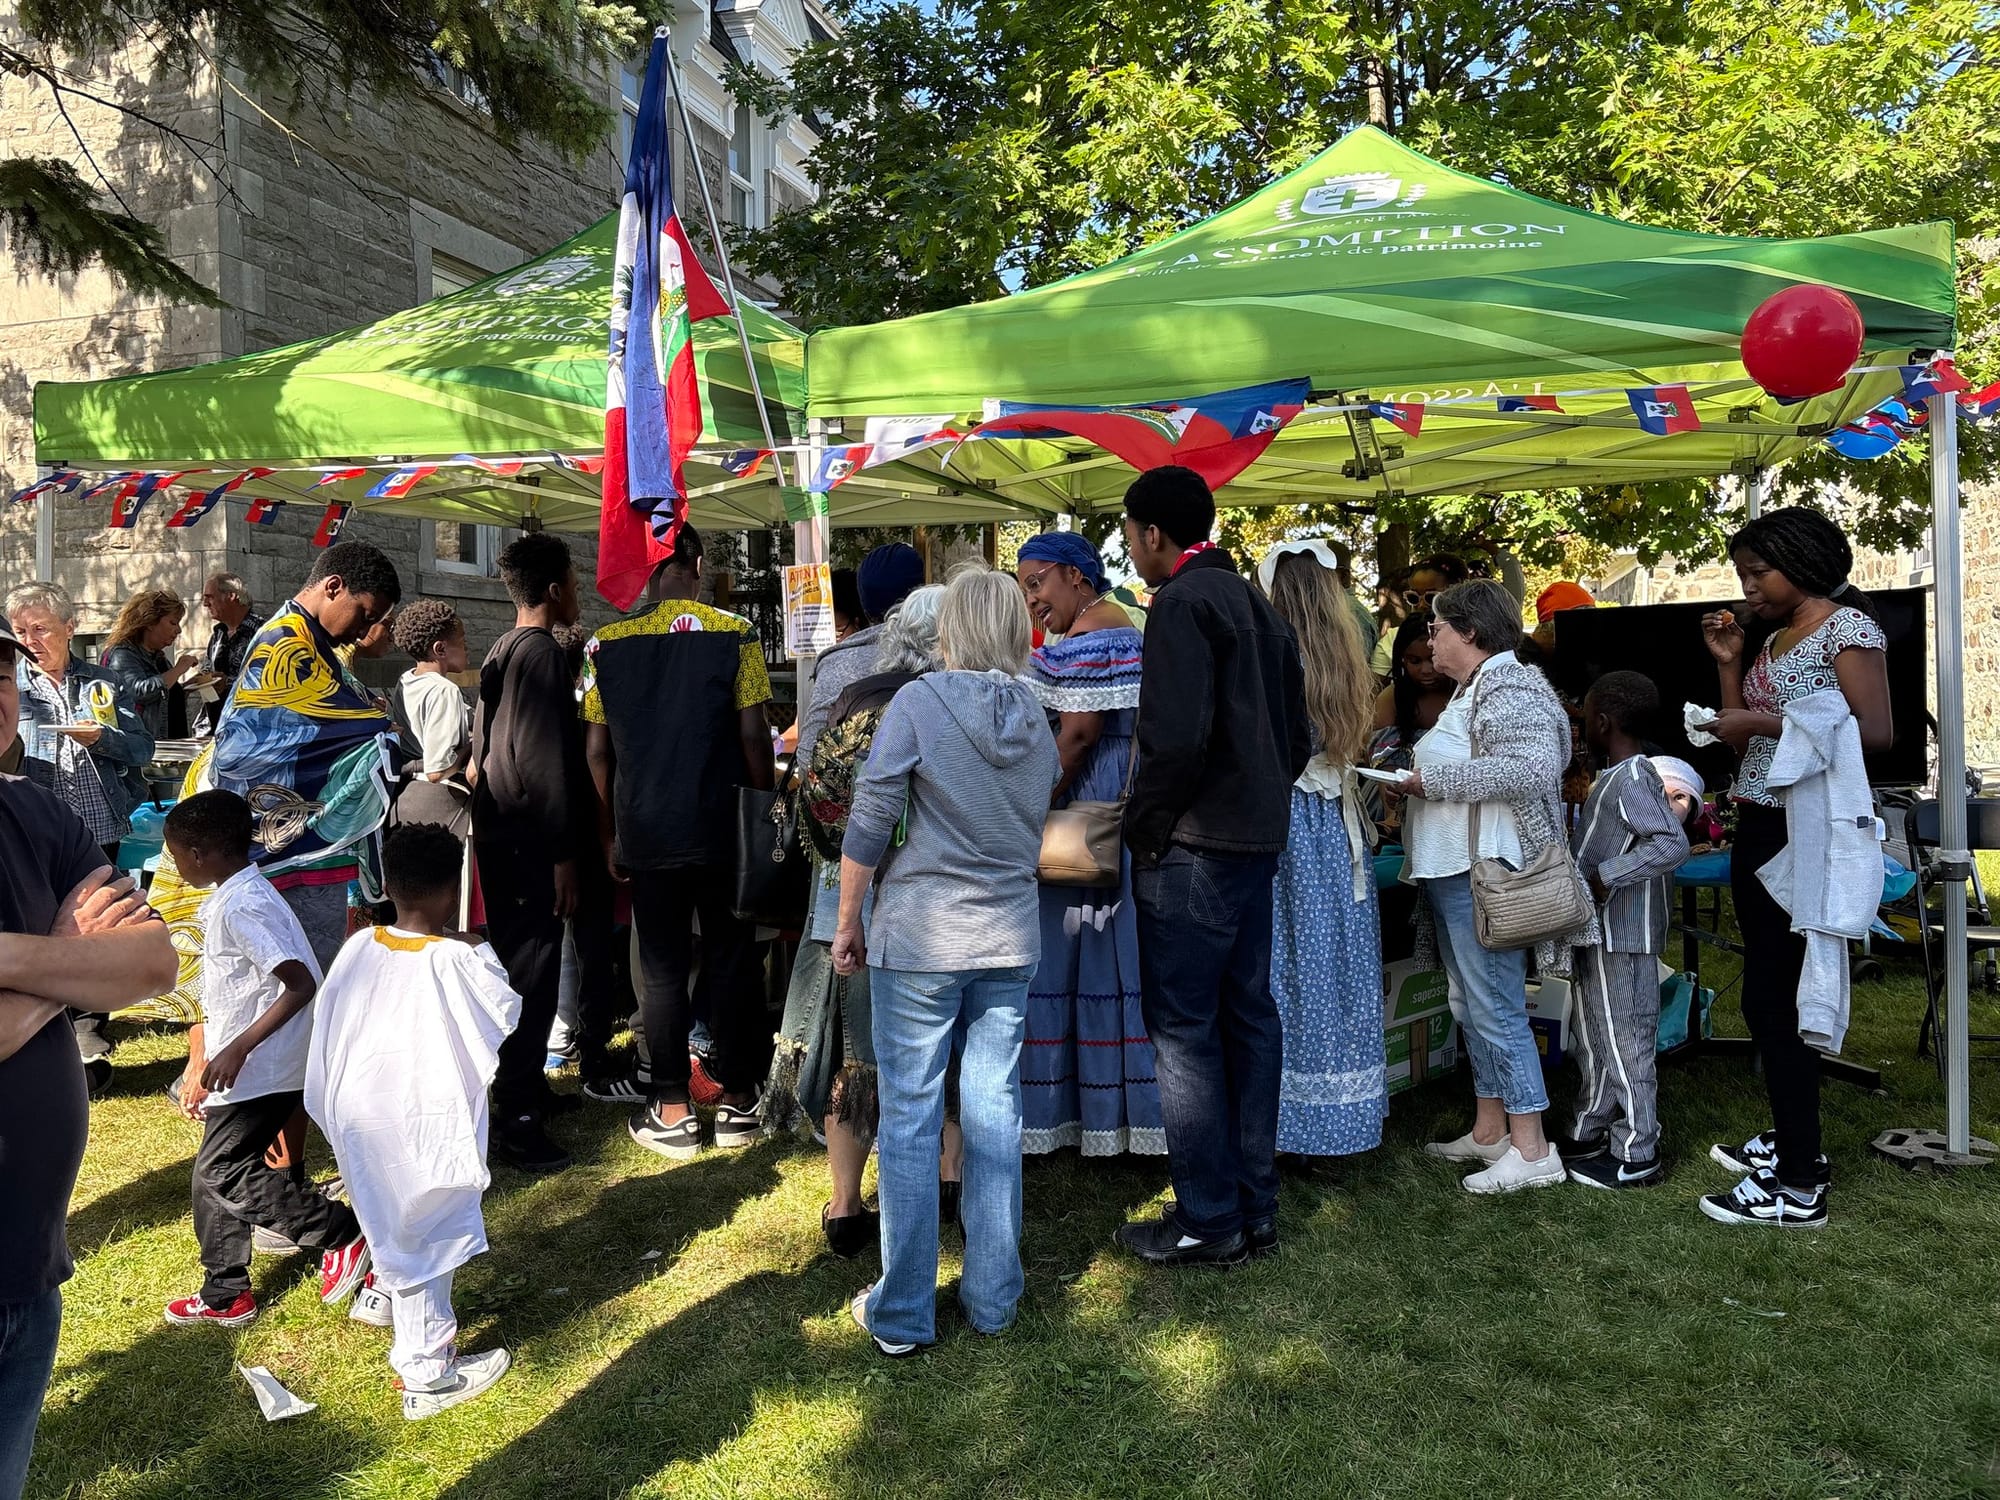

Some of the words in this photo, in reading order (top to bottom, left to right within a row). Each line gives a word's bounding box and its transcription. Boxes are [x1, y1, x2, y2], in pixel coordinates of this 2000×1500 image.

[1348, 245, 1374, 254] de
[1382, 239, 1542, 255] patrimoine
[1429, 1015, 1443, 1035] 12
[404, 1396, 417, 1408] KE
